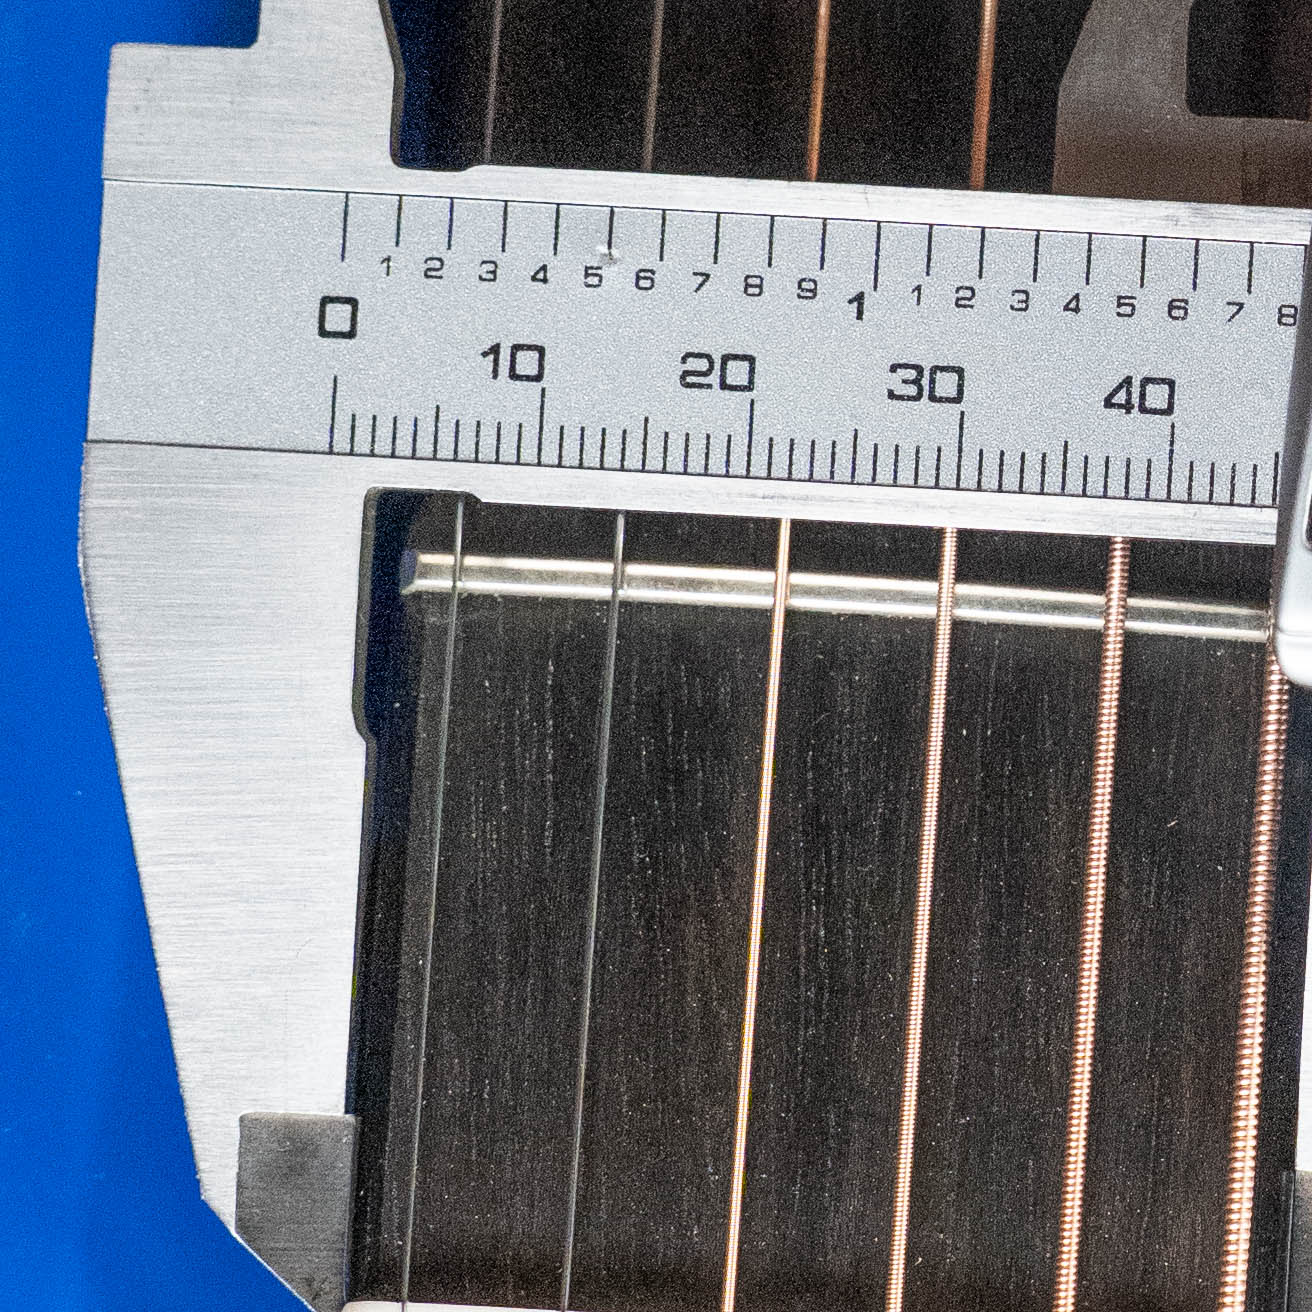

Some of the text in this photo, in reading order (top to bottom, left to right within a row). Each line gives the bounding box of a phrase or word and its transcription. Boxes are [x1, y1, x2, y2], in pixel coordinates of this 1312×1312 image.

[380, 255, 1299, 326] 1 2 3 4 5 6 7 8 9 1 1 2 3 4 5 6 7 8
[317, 296, 1176, 416] 0 10 20 30 40
